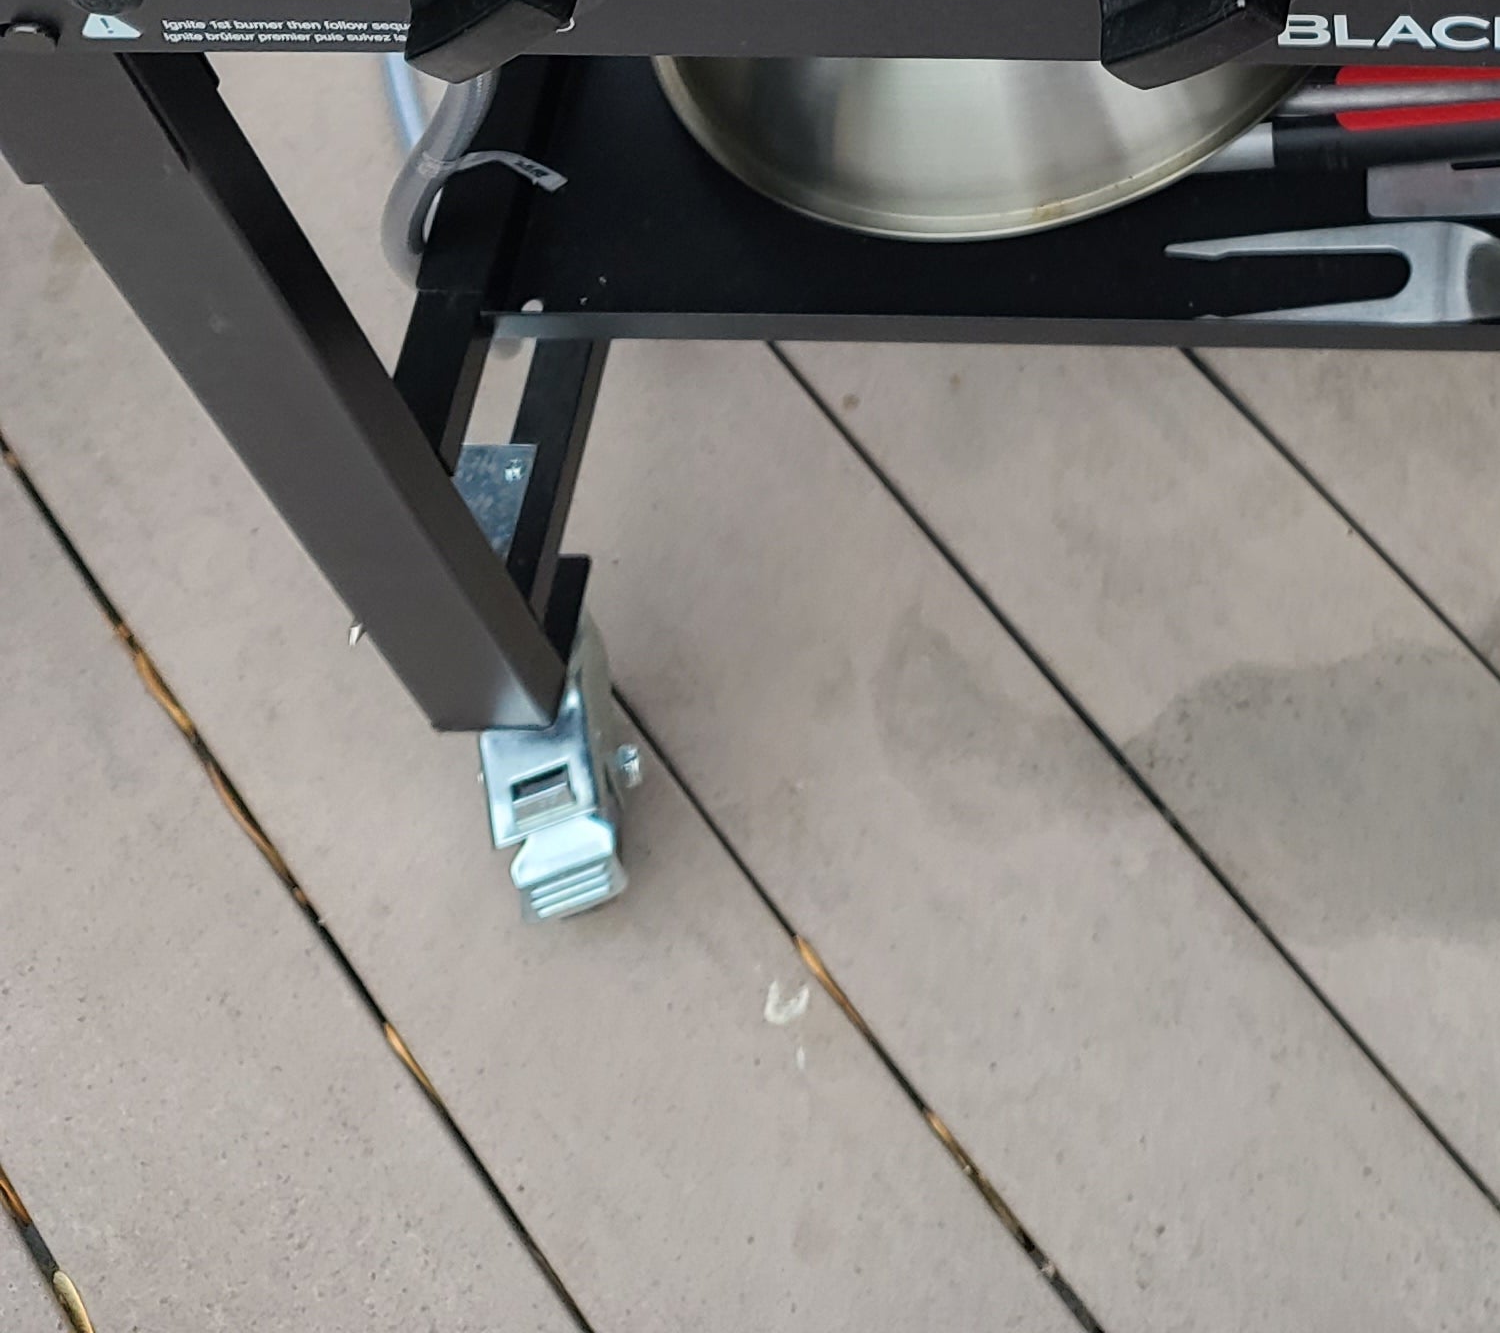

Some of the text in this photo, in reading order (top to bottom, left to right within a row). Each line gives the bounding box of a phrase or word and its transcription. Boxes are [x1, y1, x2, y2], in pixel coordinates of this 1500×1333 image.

[161, 20, 206, 32] Ignite
[287, 21, 322, 31] then
[324, 21, 369, 31] follow
[371, 22, 411, 34] sequ
[163, 32, 205, 43] Ignite
[258, 33, 313, 44] premier
